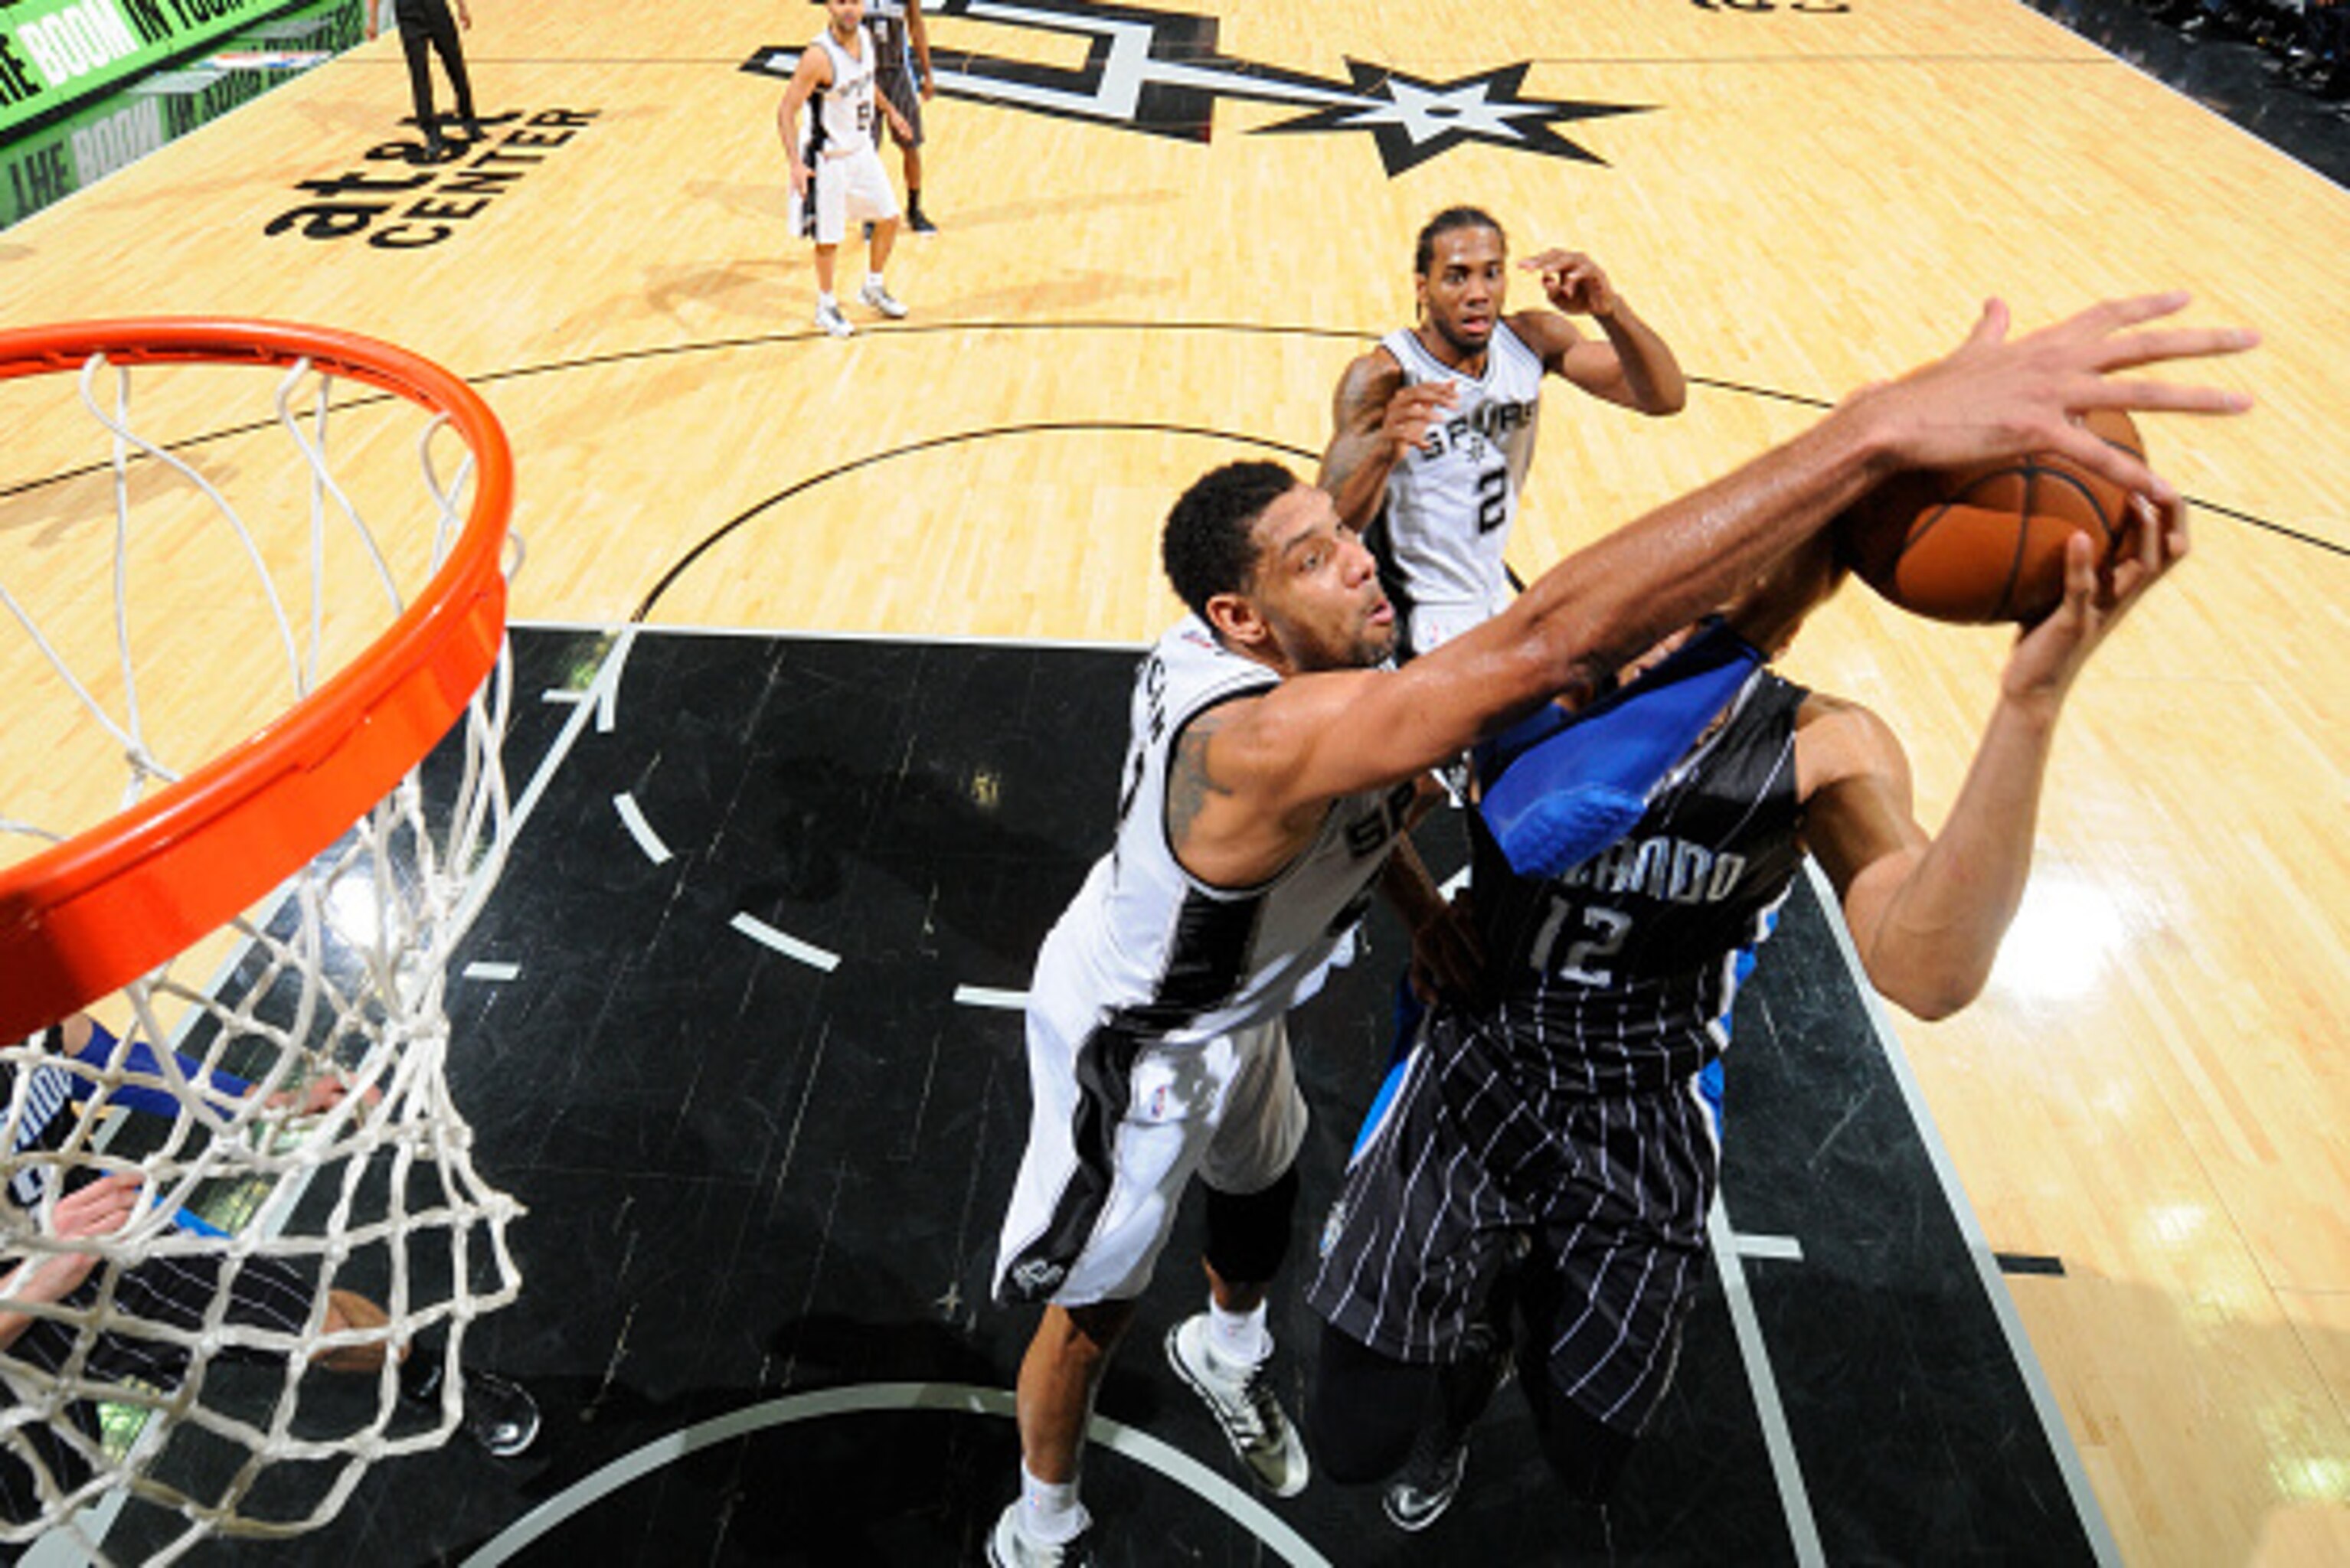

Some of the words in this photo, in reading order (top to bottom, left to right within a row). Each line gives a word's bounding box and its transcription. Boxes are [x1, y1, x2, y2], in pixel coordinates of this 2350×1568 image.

[17, 0, 139, 88] BOOM
[368, 109, 603, 249] CENTER
[1476, 467, 1505, 534] 2
[1530, 894, 1632, 988] 12
